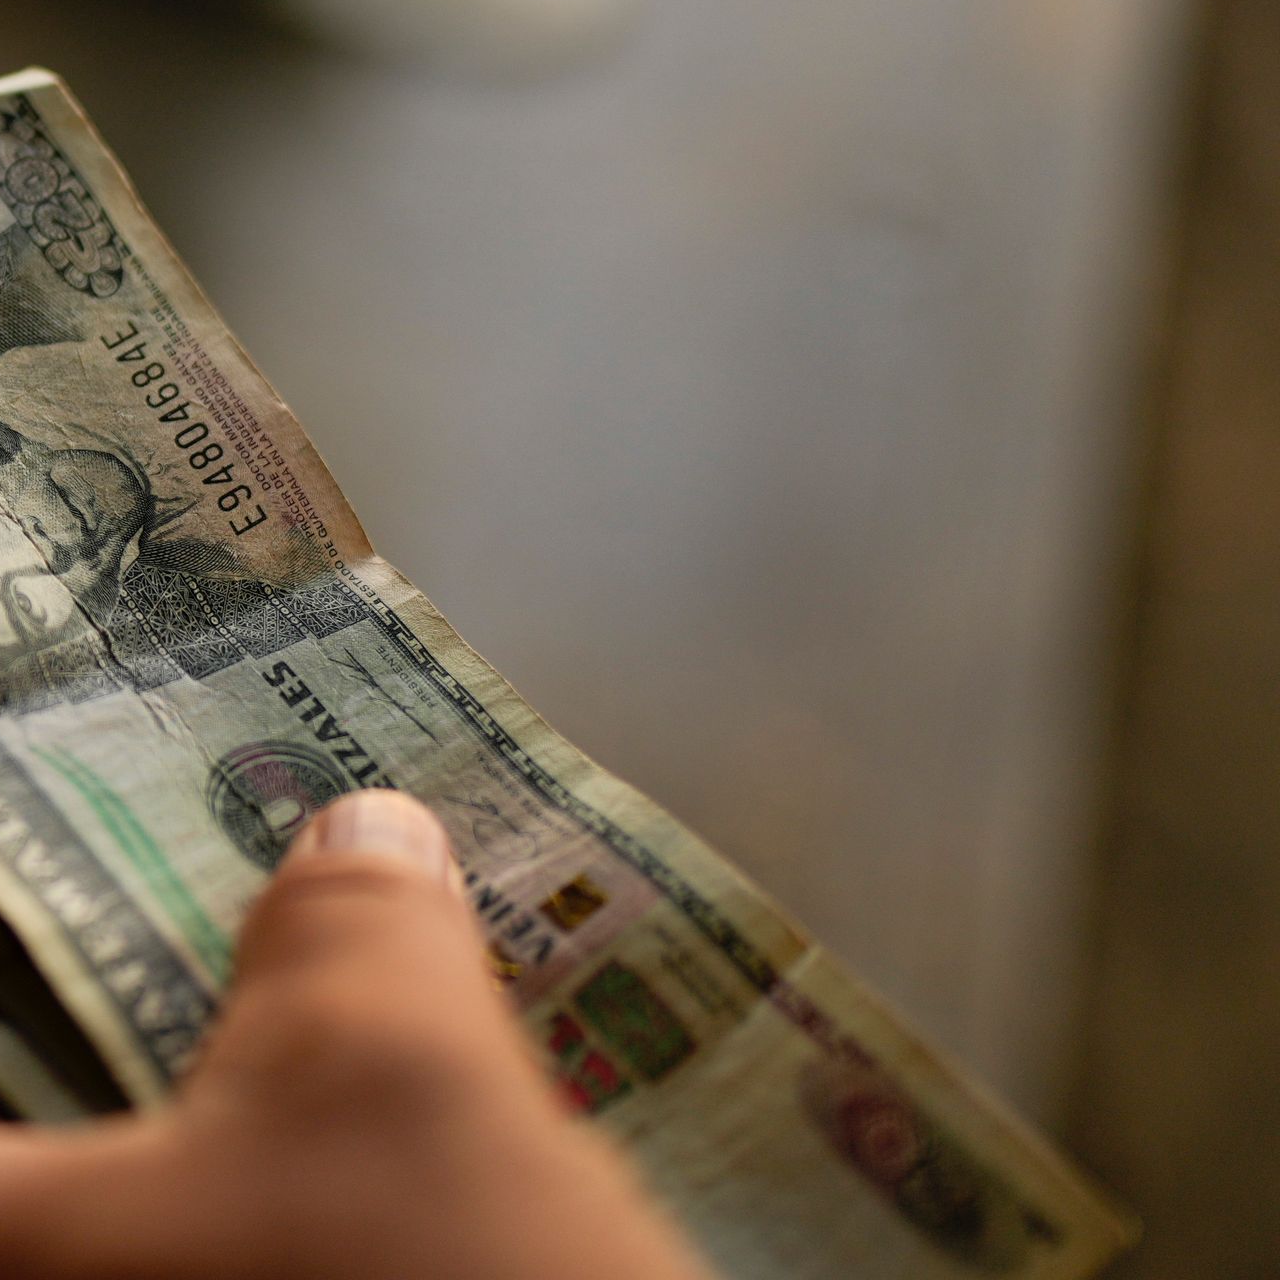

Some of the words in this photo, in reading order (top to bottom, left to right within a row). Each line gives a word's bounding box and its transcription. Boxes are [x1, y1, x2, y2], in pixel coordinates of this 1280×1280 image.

[100, 318, 268, 537] E94804684E
[189, 360, 259, 450] INDEPENDENCIA
[193, 386, 238, 440] MARIANO
[234, 441, 271, 491] DOCTOR
[255, 451, 270, 468] LA
[257, 433, 273, 449] LA
[269, 449, 284, 466] EN
[268, 471, 284, 489] DE
[280, 465, 328, 539] GUATEMALA
[324, 539, 338, 558] DE
[333, 559, 376, 598] ESTADO
[375, 645, 438, 709] PRESIDENTE
[261, 657, 395, 802] ETZALES
